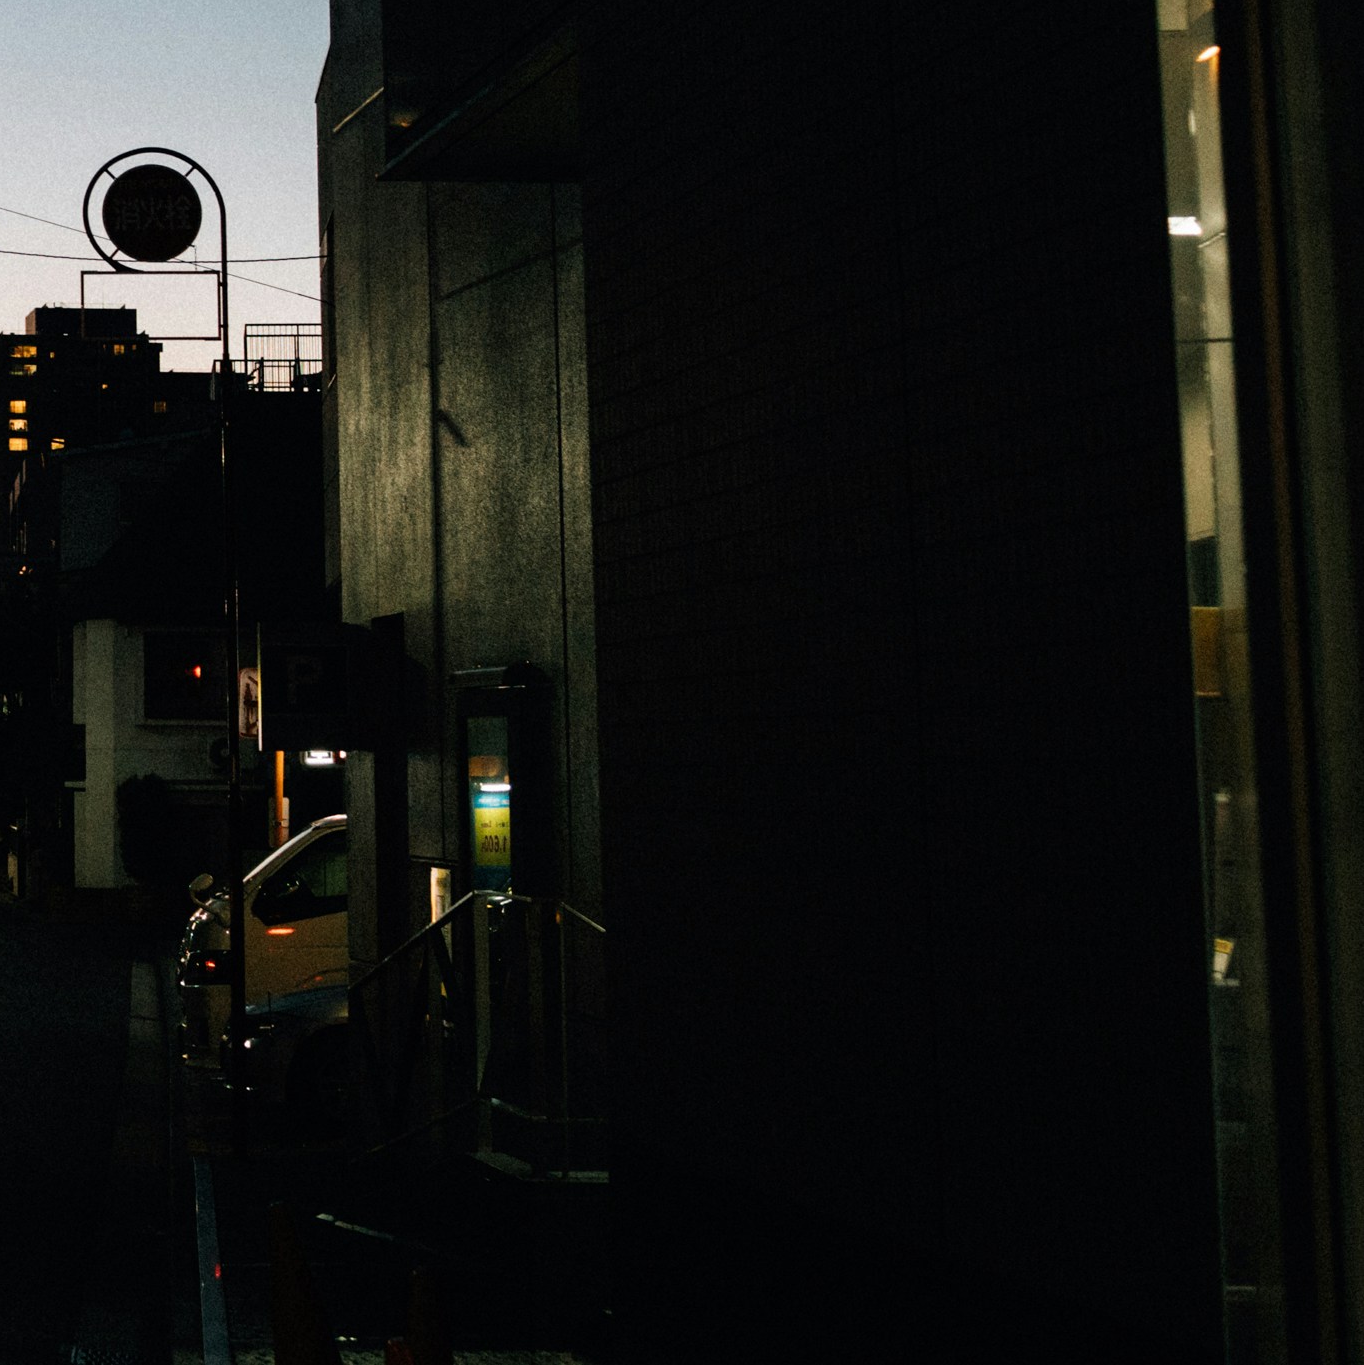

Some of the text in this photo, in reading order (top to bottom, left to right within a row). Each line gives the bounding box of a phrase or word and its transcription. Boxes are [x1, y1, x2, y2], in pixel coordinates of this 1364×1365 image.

[108, 194, 193, 231] 消火栓
[286, 654, 323, 704] P
